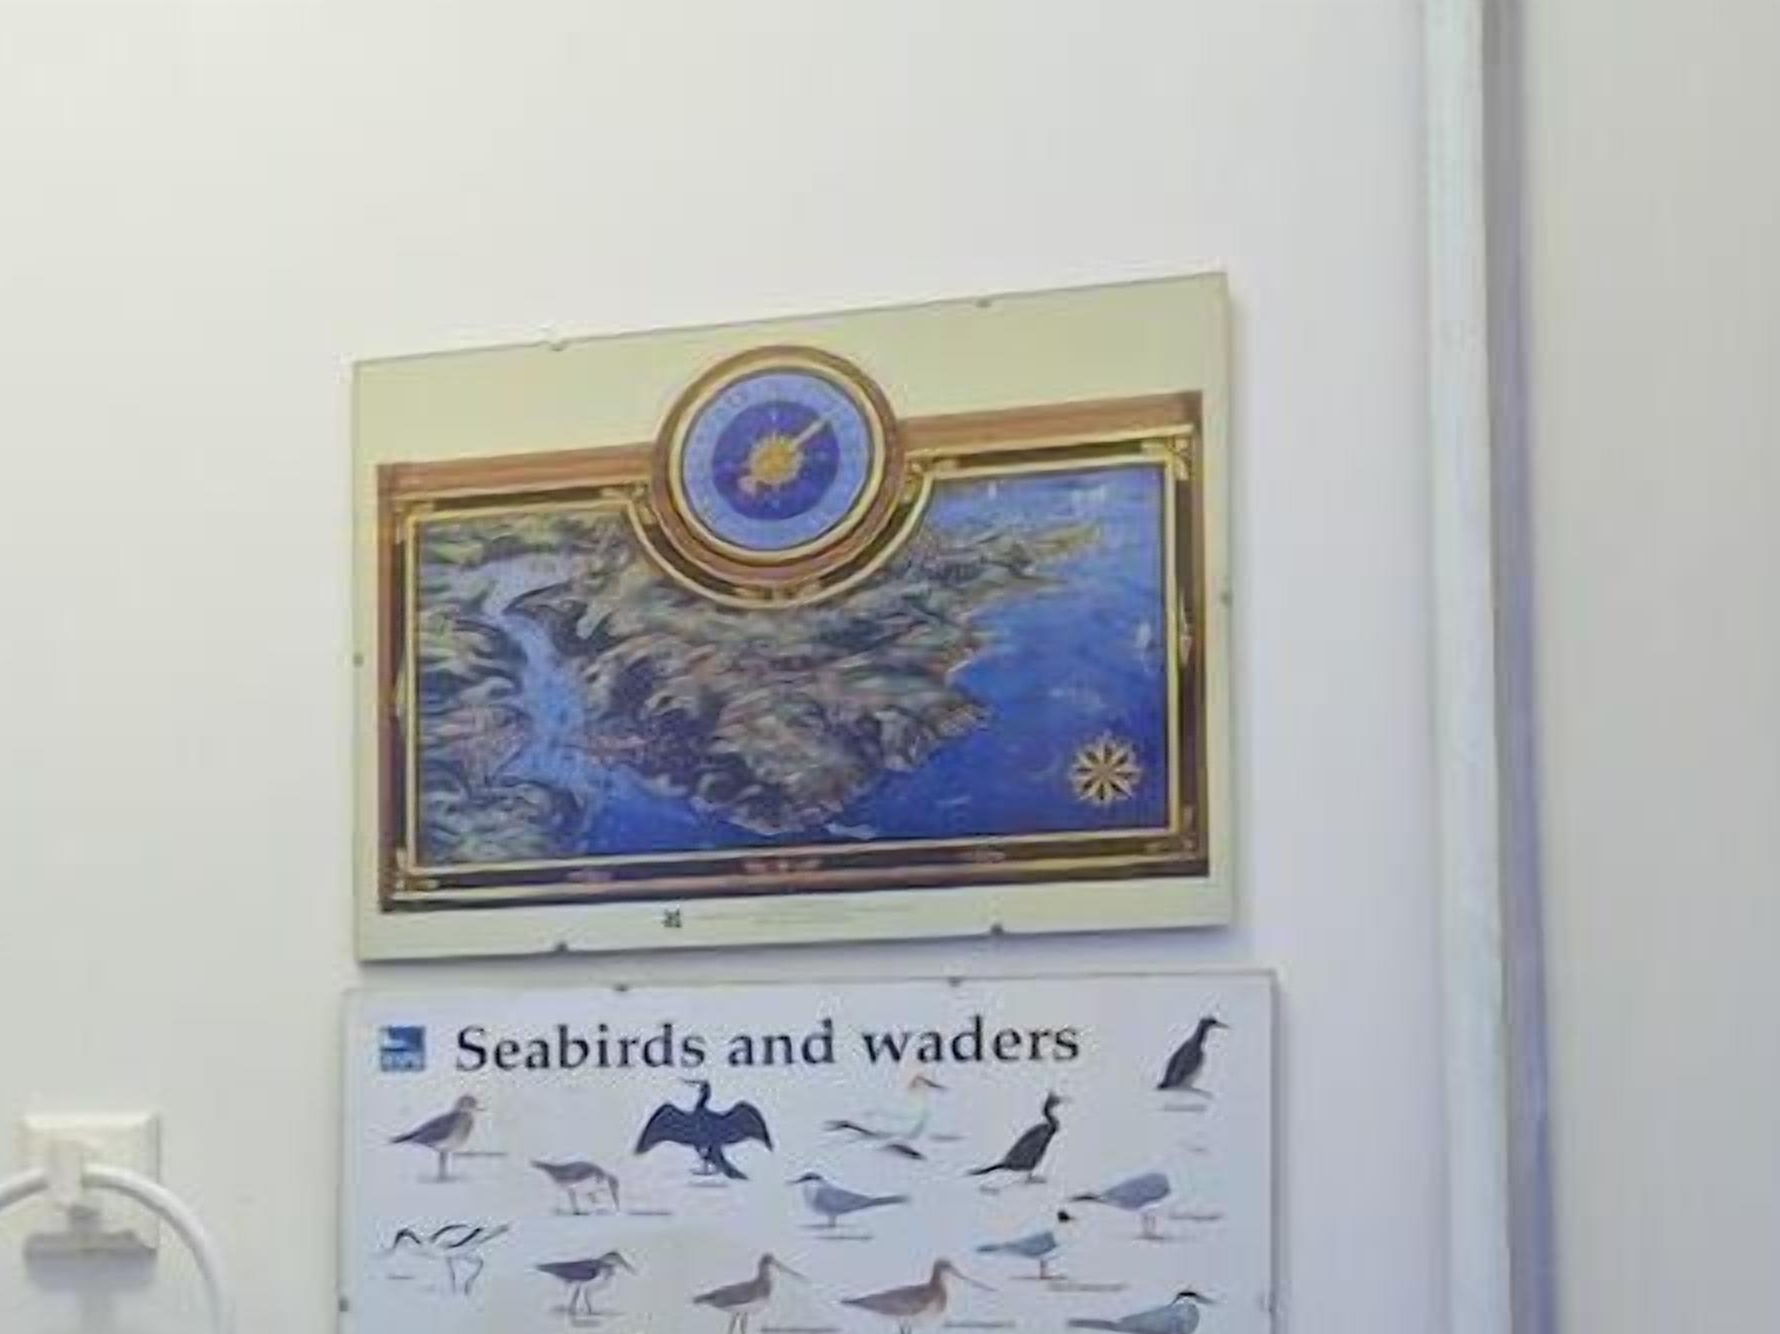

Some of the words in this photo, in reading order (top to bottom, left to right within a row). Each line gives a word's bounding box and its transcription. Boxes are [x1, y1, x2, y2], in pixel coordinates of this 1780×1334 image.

[455, 1023, 706, 1072] Seabirds
[727, 1017, 836, 1067] and
[861, 1014, 1081, 1063] waders
